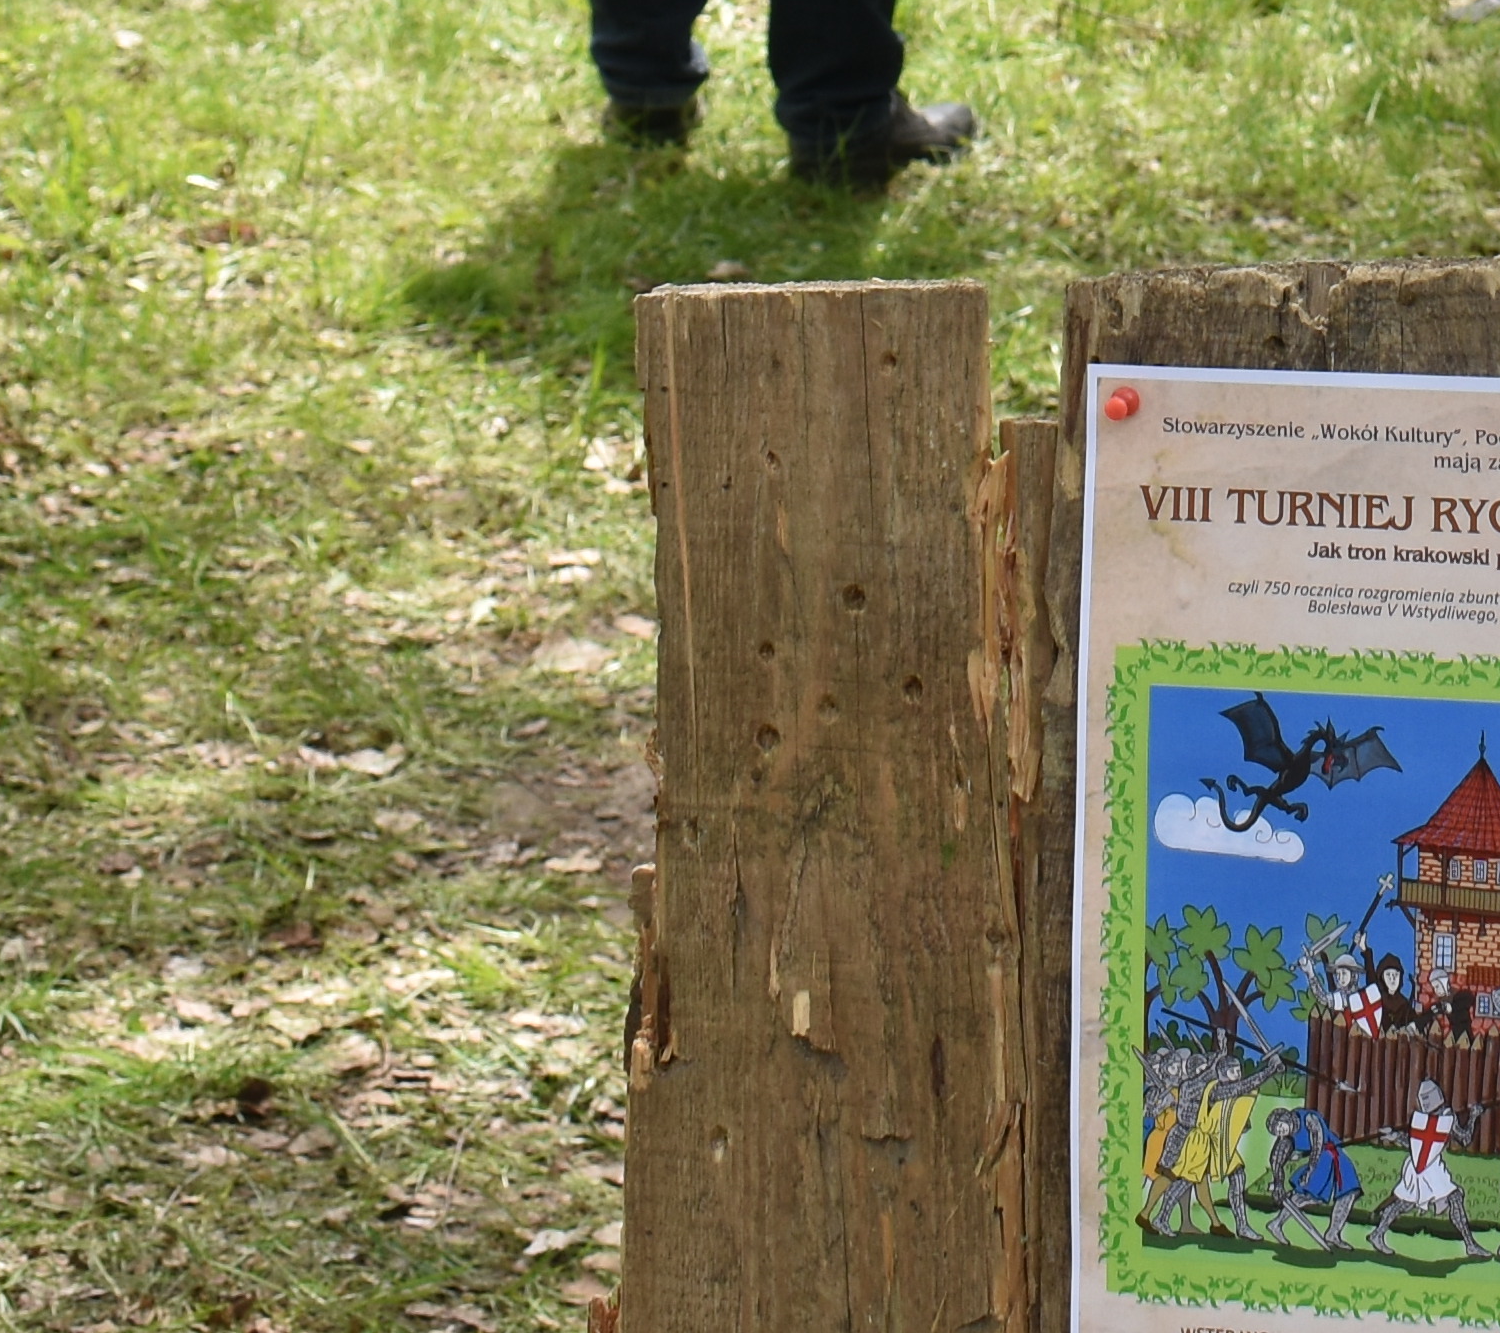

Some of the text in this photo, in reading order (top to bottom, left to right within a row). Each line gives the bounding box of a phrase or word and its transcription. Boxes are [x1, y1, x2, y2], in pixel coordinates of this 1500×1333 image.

[1162, 416, 1305, 442] Stowarzyszenie
[1433, 452, 1482, 476] mają
[1139, 484, 1213, 523] VIII
[1225, 488, 1416, 531] TURNIEJ
[1307, 541, 1343, 565] Jak
[1347, 544, 1387, 562] tron
[1392, 545, 1490, 566] krakowski
[1227, 579, 1259, 599] czyli
[1263, 580, 1291, 596] 750
[1293, 582, 1354, 599] rocznica
[1357, 586, 1455, 605] rozgromienia
[1307, 598, 1383, 616] Bolesława
[1387, 601, 1398, 617] V
[1402, 602, 1499, 626] Wstydliwego,
